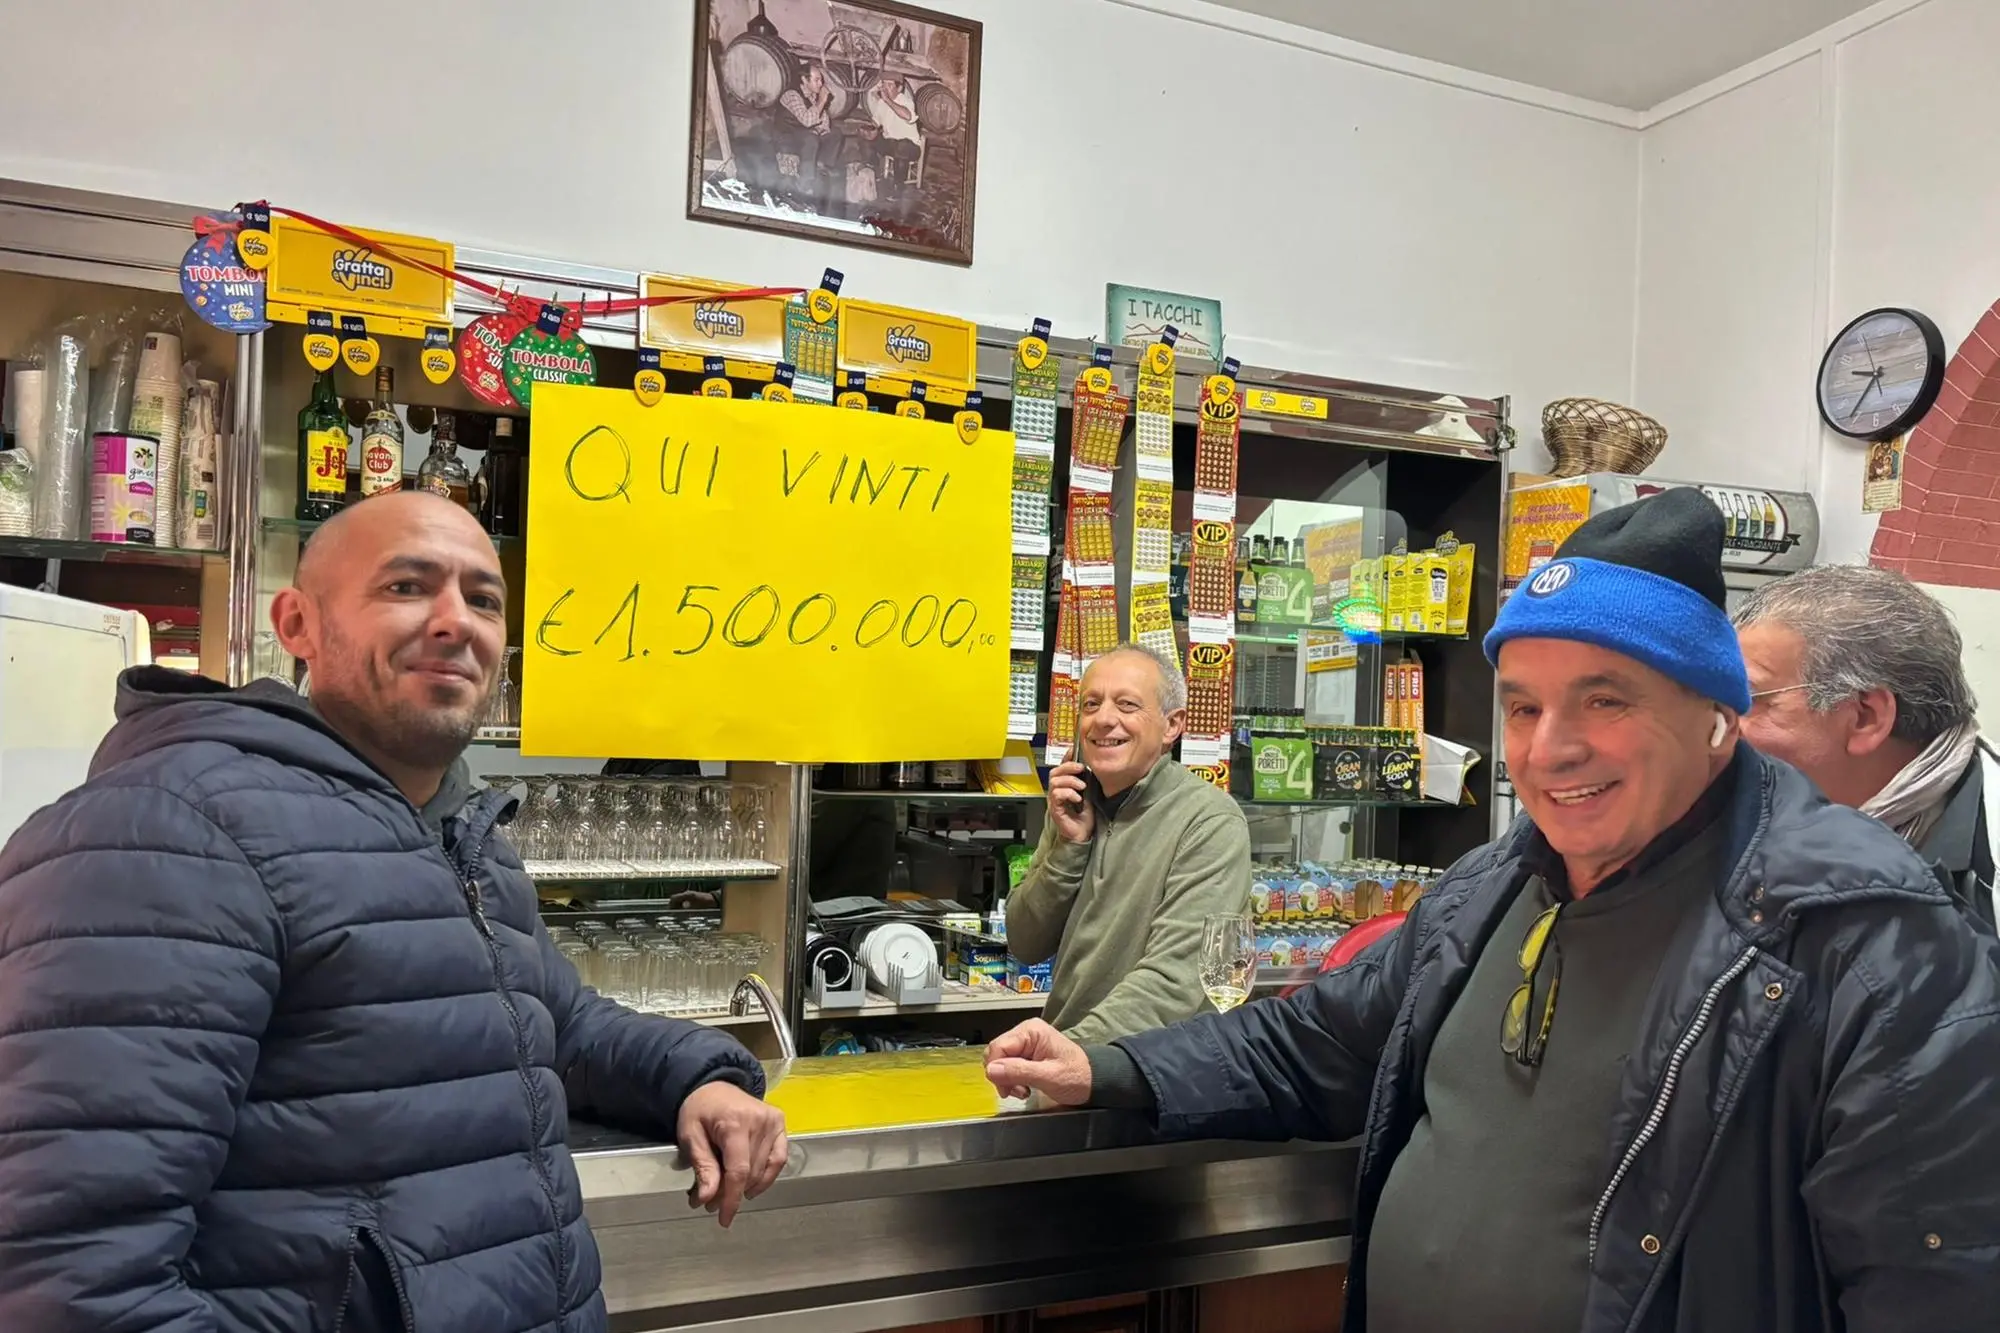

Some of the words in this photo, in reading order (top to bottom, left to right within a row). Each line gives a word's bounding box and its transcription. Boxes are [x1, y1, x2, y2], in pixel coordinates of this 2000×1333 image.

[334, 258, 384, 277] Gratta
[339, 268, 393, 291] Vinci!
[223, 283, 254, 297] MINI
[696, 308, 738, 326] Gratta
[1128, 298, 1137, 317] I
[1142, 299, 1203, 327] TACCHI
[888, 334, 925, 351] Gratta
[510, 348, 592, 375] TOMBOLA
[532, 368, 568, 384] CLASSIC
[1207, 400, 1234, 418] VIP
[369, 459, 389, 470] Club
[564, 425, 719, 503] QUI
[782, 448, 951, 513] VINTI
[1200, 525, 1226, 541] VIP
[1196, 648, 1222, 664] VIP
[1257, 757, 1286, 770] PORETTI
[1382, 759, 1414, 777] LEMON
[1287, 751, 1313, 796] 4
[1336, 771, 1360, 782] SODA
[1385, 771, 1410, 782] SODA
